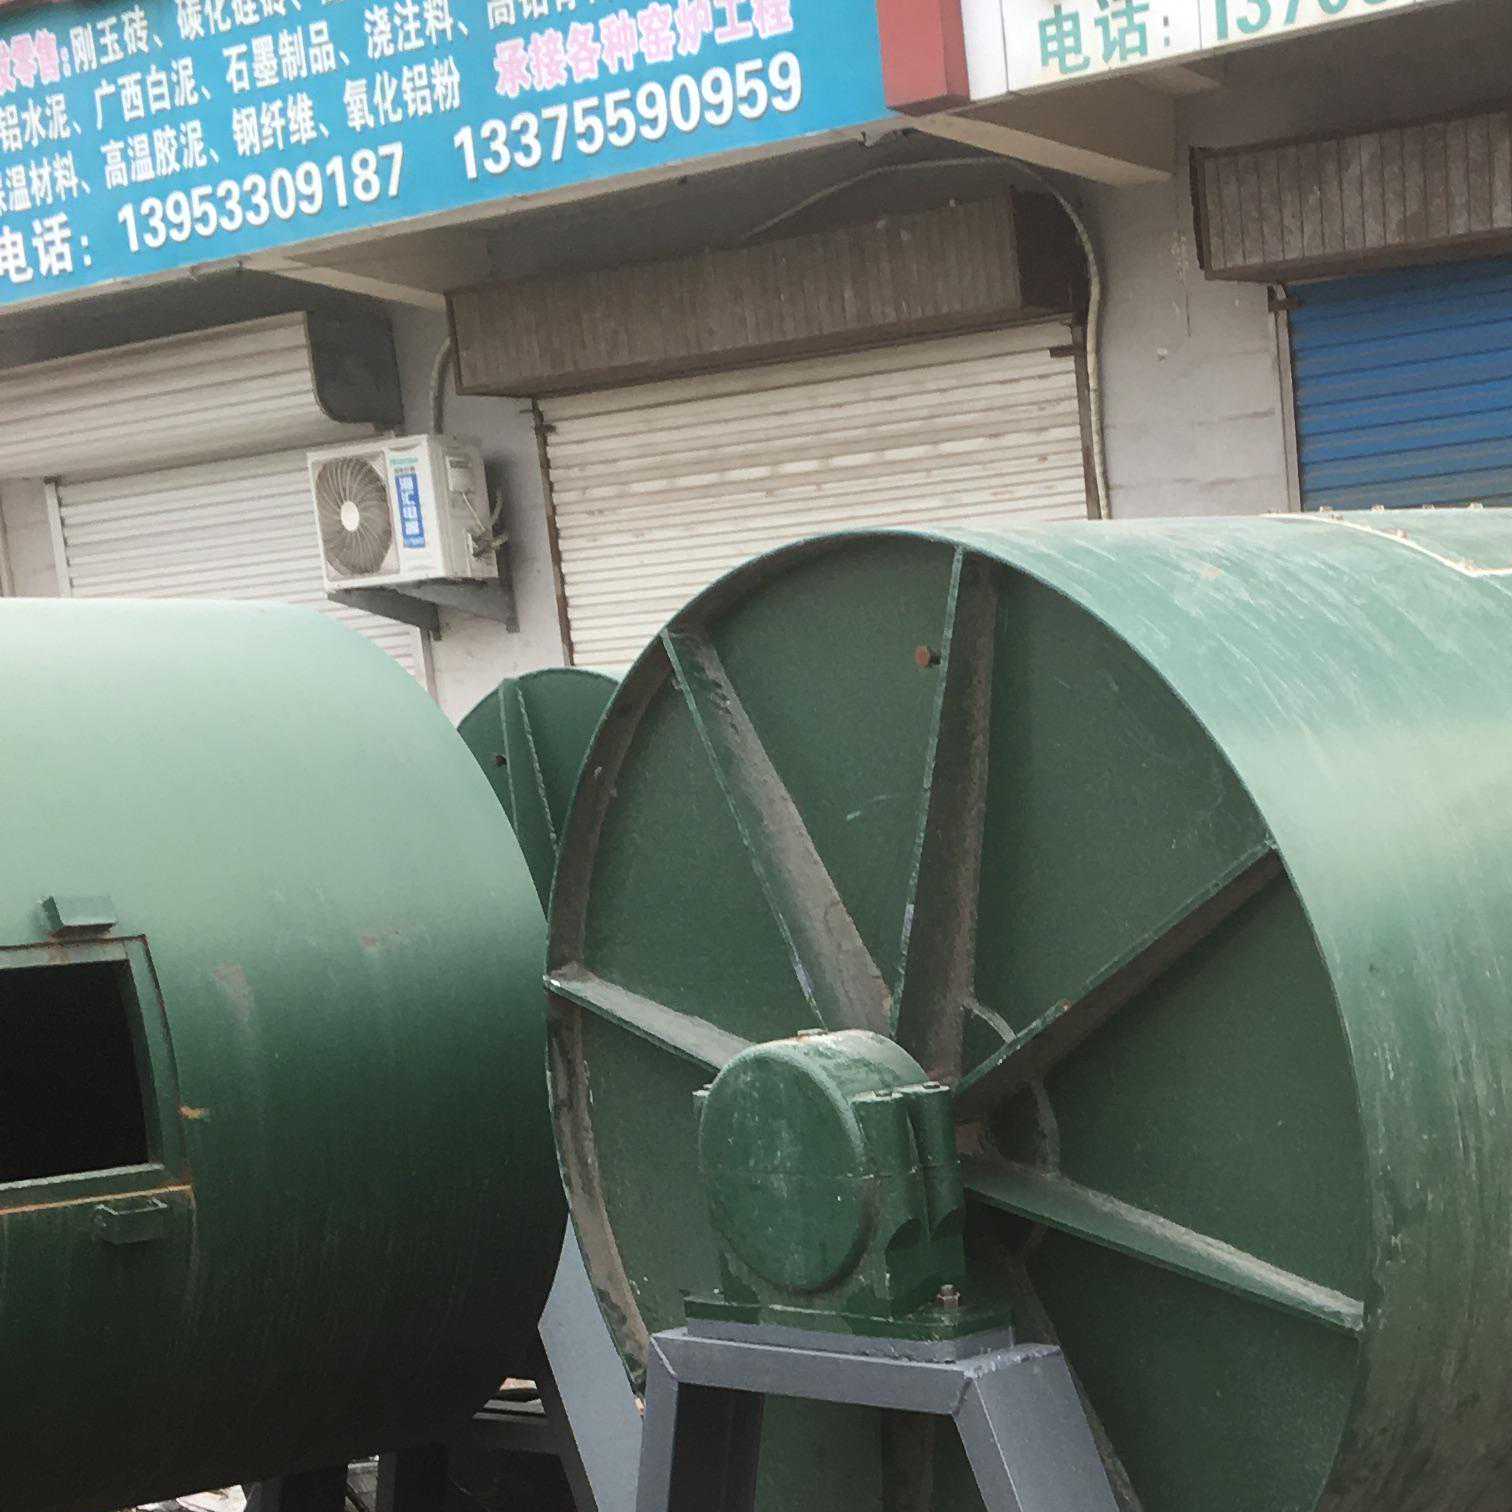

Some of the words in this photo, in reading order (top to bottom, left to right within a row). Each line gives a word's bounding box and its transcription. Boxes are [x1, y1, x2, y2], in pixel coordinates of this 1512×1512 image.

[1038, 0, 1171, 74] 电话：
[118, 142, 403, 253] 13953309187
[453, 51, 802, 180] 13375590959
